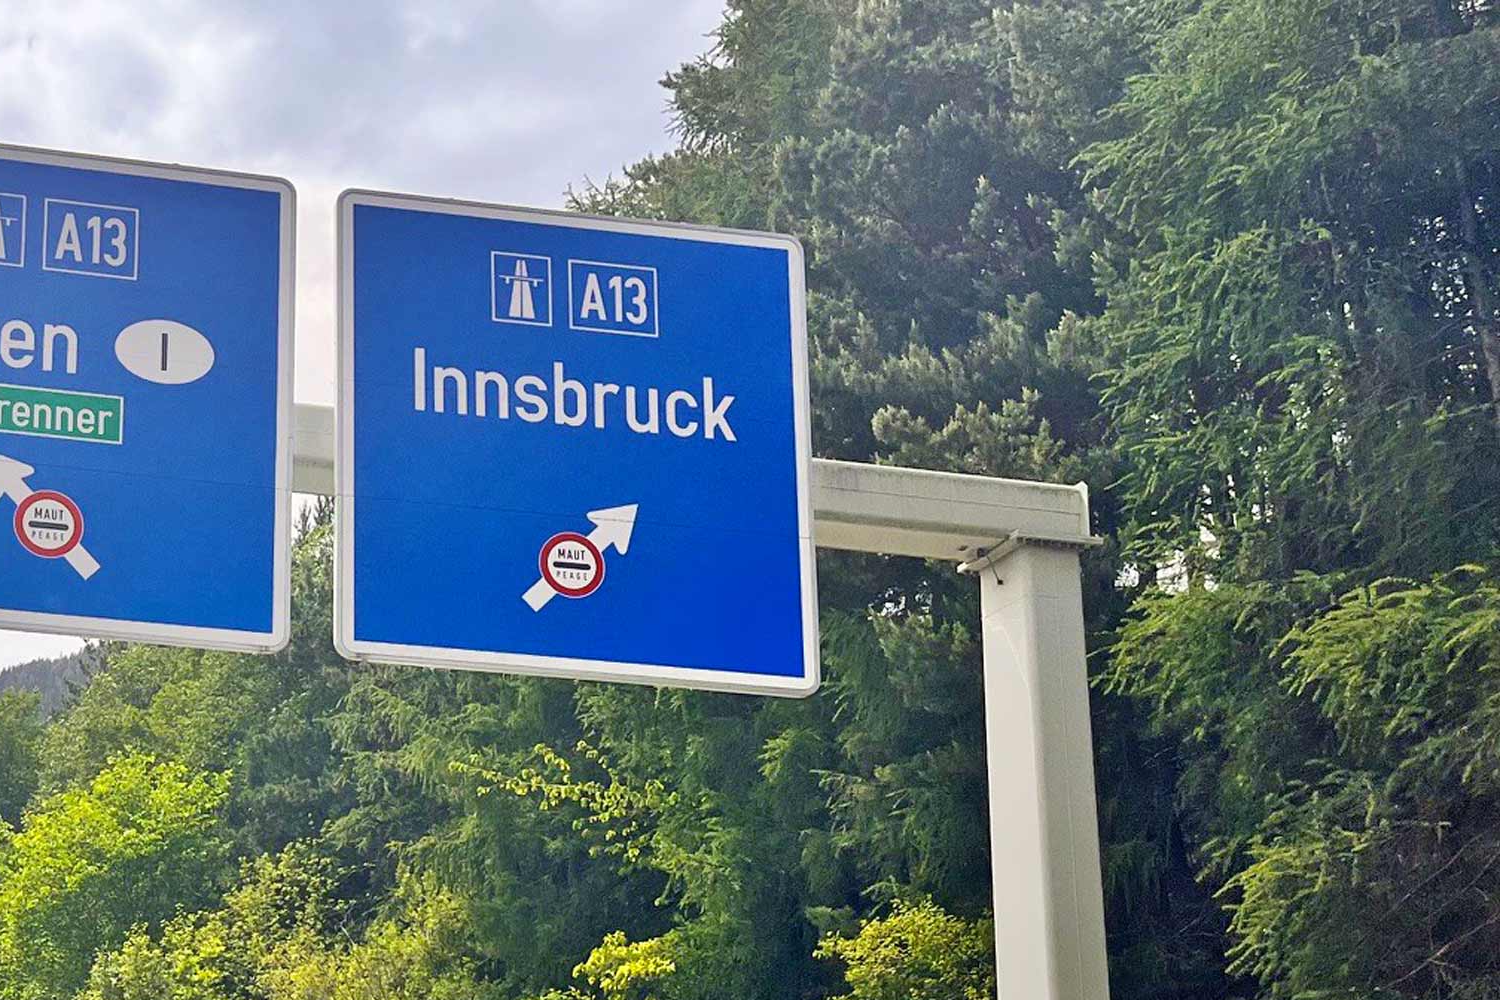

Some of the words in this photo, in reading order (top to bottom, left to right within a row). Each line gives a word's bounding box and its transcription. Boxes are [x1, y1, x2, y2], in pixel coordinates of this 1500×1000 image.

[54, 212, 127, 268] A13
[580, 272, 648, 325] A13
[413, 347, 738, 441] Innsbruck
[33, 507, 64, 521] MAUT
[557, 548, 586, 561] MAUT
